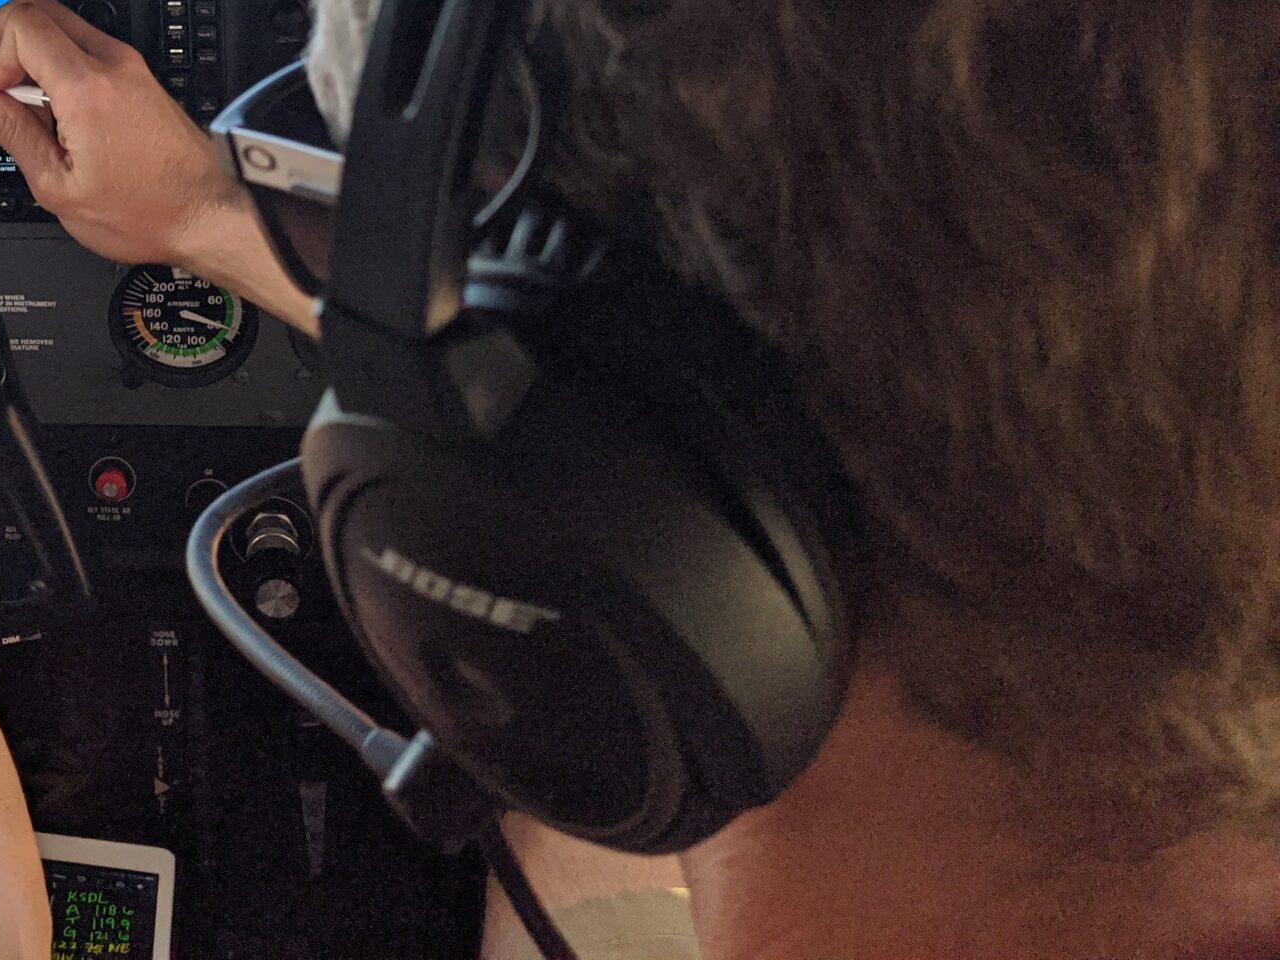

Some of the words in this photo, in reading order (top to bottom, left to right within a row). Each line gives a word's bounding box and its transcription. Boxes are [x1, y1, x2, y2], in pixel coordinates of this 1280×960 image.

[152, 282, 175, 292] 200
[194, 280, 210, 289] 40
[146, 294, 164, 303] 180
[208, 295, 223, 305] 60
[142, 308, 161, 318] 160
[150, 321, 168, 331] 140
[162, 334, 181, 344] 120
[187, 336, 206, 346] 100
[2, 635, 20, 644] DIM
[66, 904, 80, 916] A
